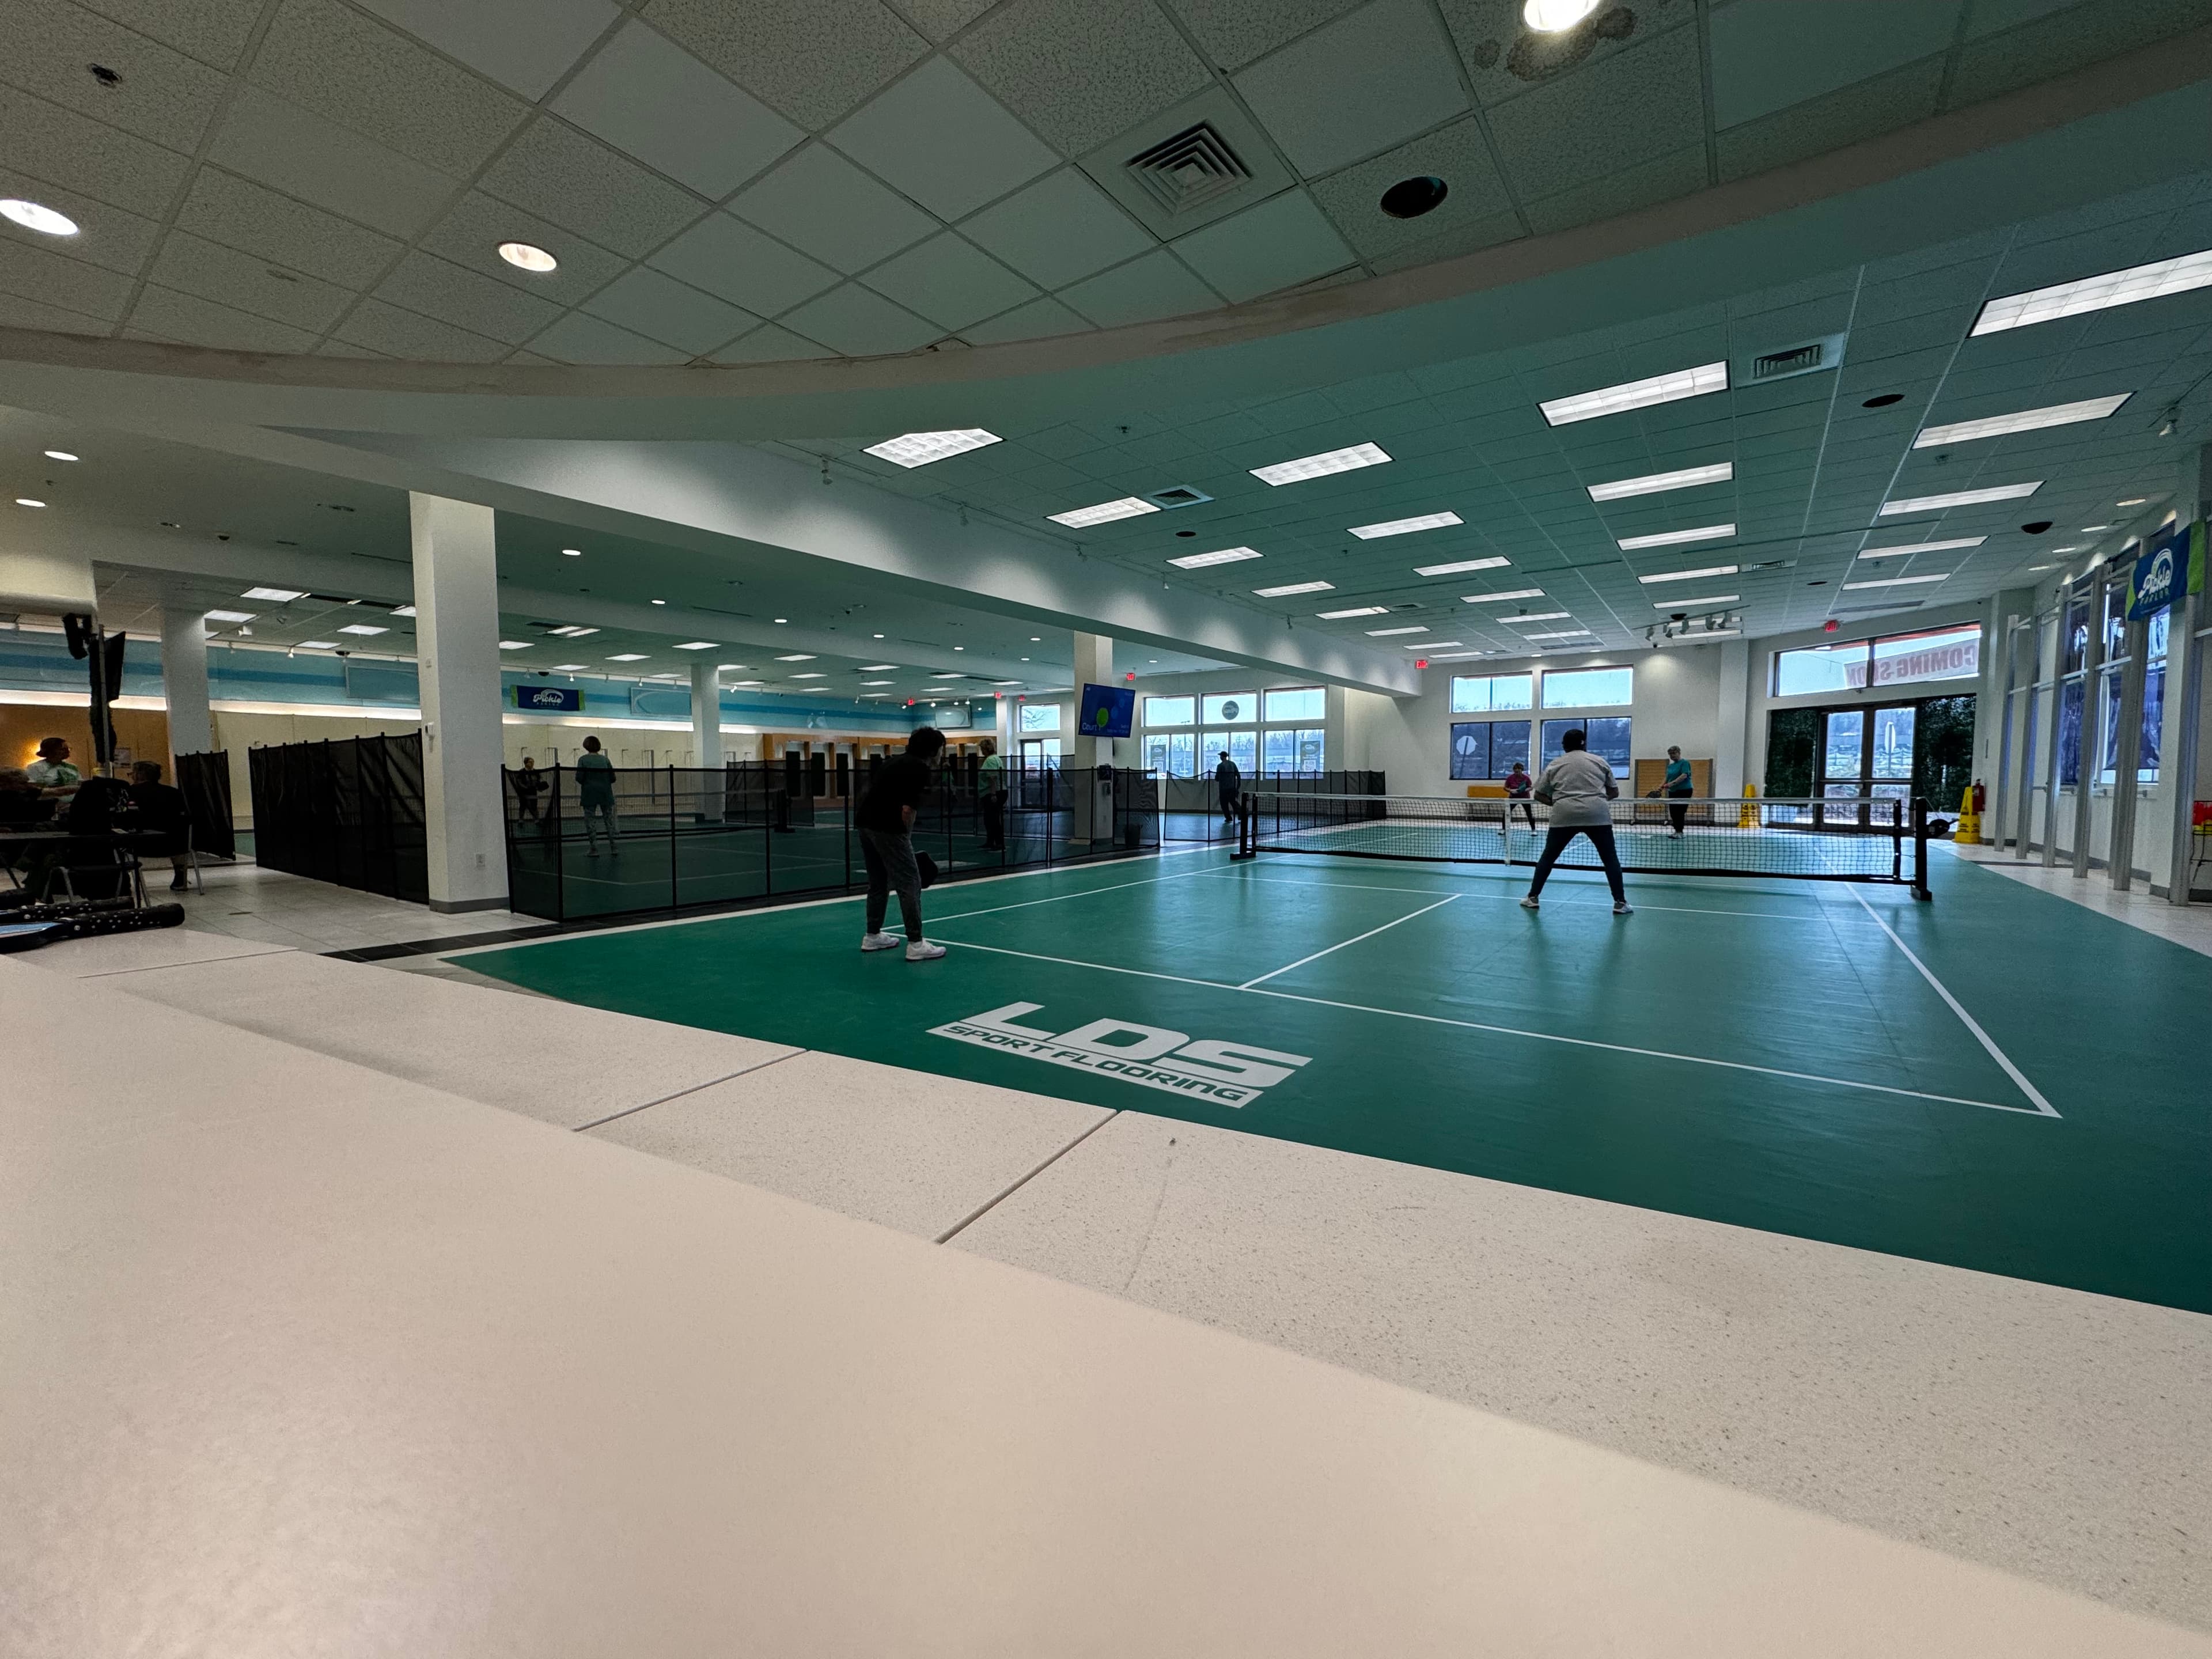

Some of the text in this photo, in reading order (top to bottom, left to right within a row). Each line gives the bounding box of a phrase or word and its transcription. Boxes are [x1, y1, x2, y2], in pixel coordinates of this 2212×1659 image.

[2138, 565, 2171, 599] Pickle
[533, 694, 563, 703] Pickle
[942, 1025, 1249, 1101] SPORT FLOORING
[959, 1001, 1313, 1088] LDS
